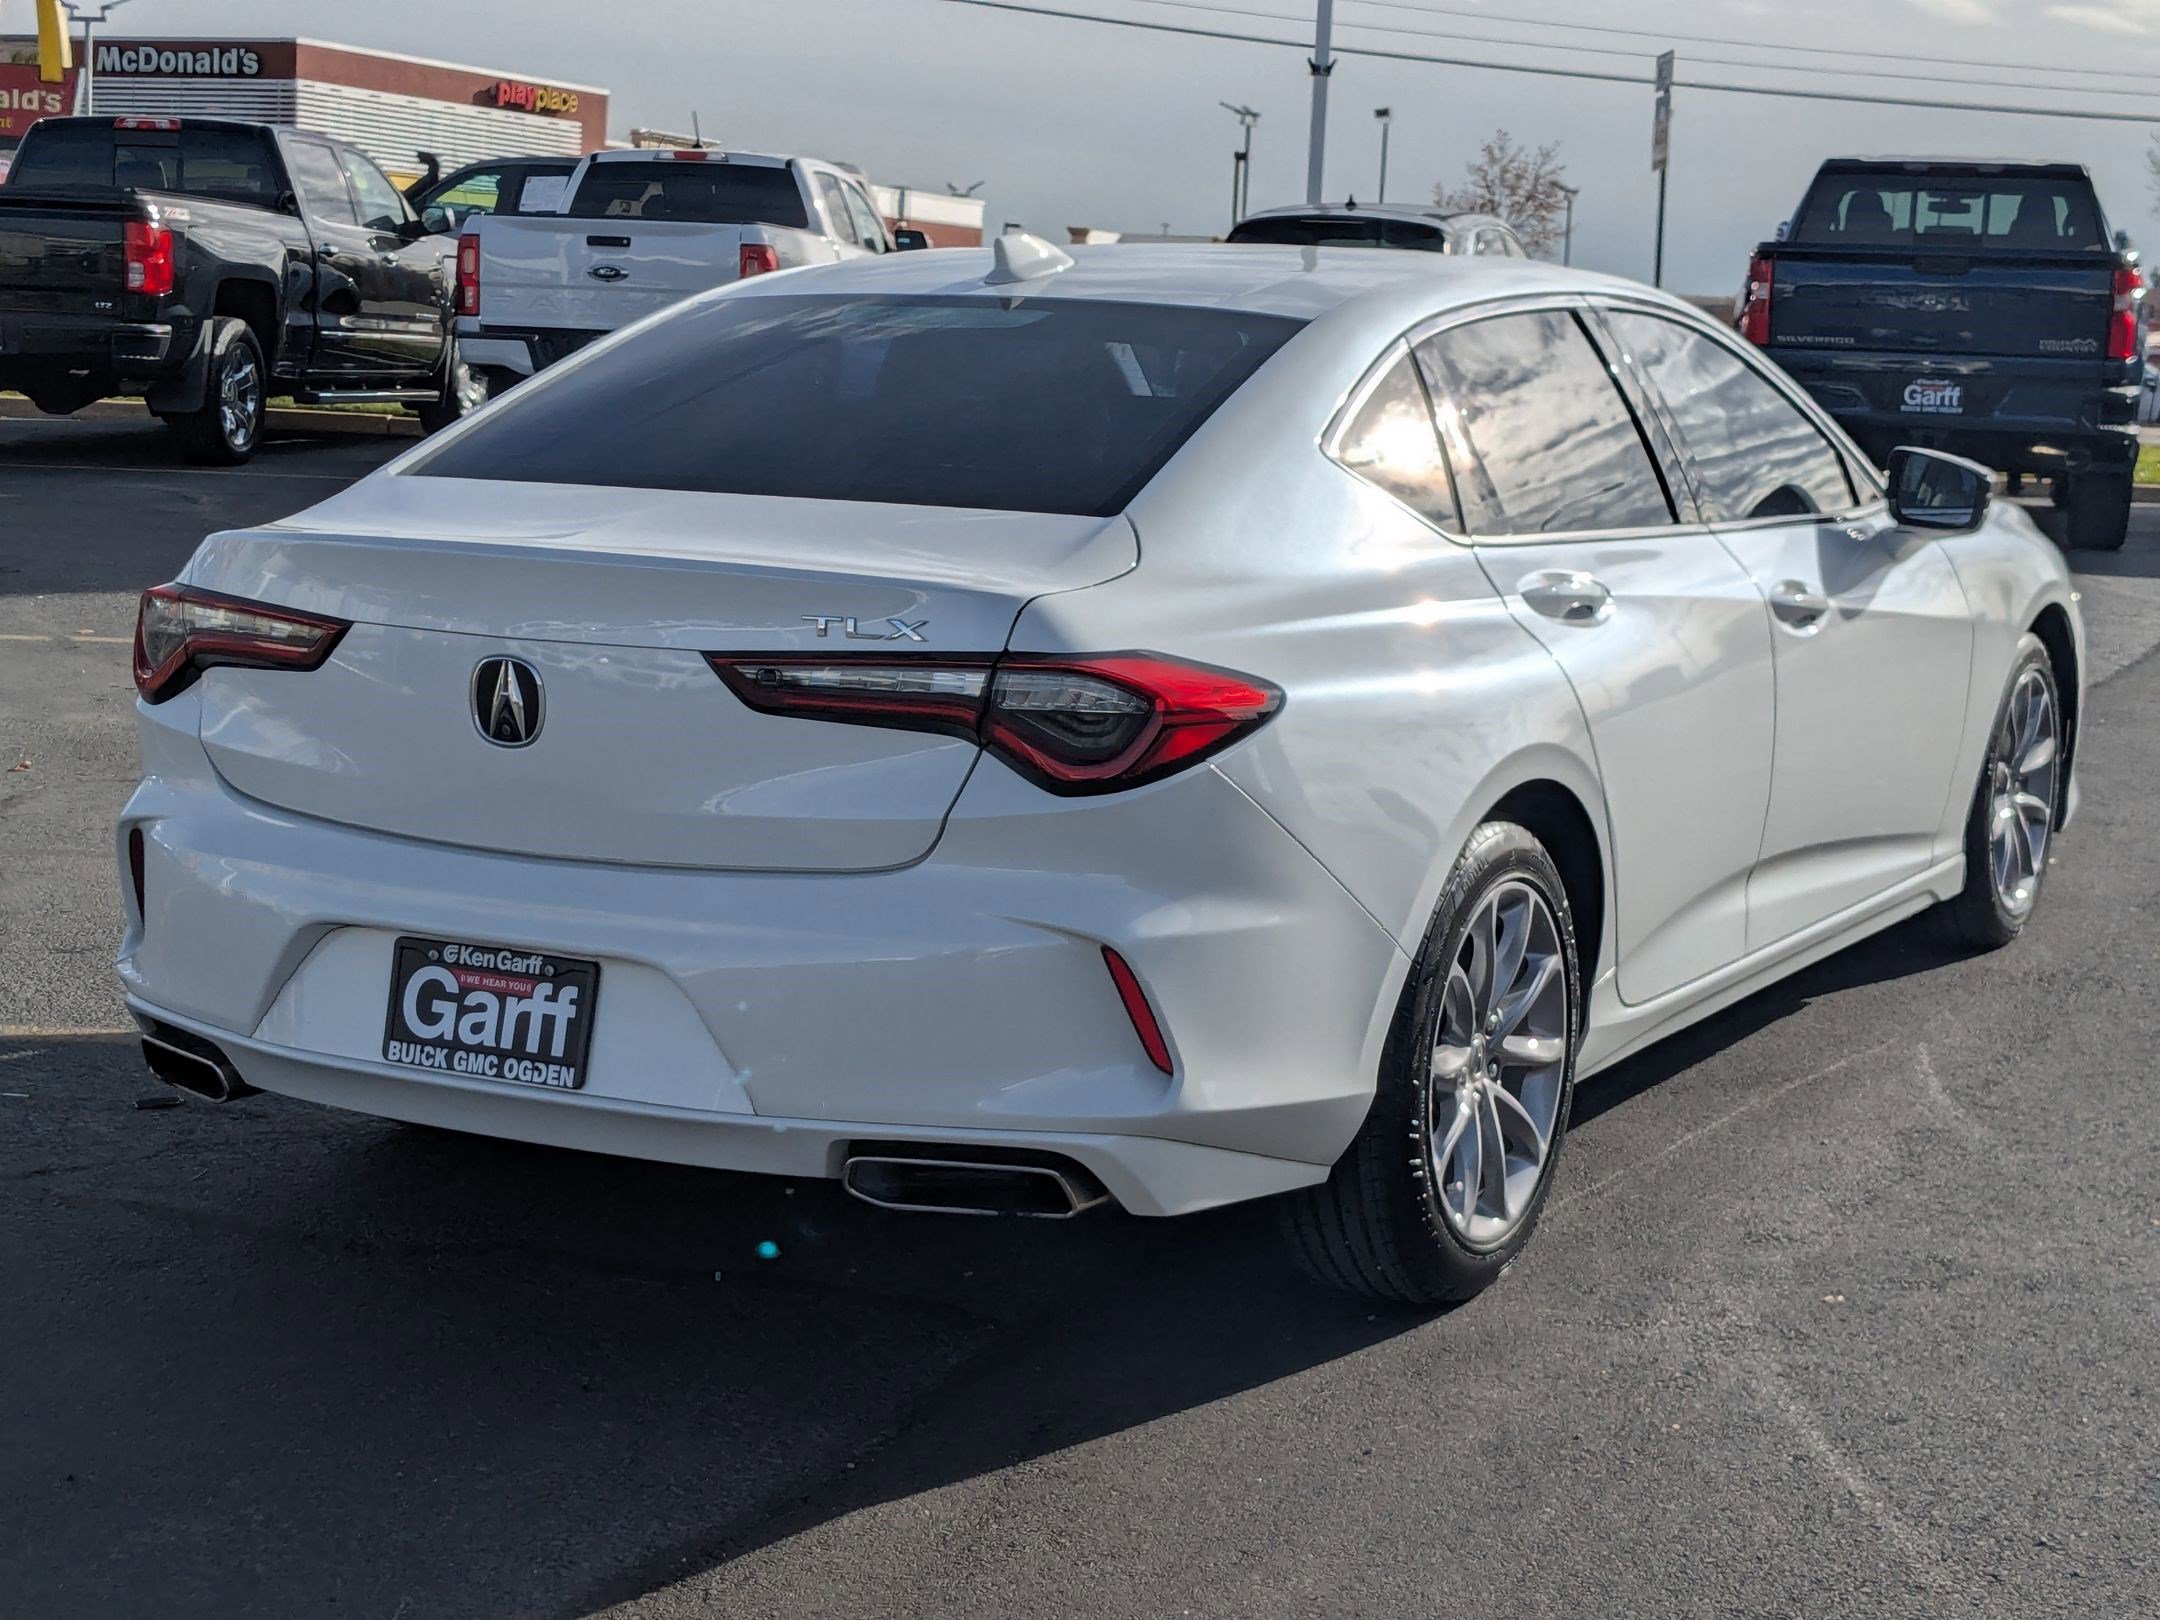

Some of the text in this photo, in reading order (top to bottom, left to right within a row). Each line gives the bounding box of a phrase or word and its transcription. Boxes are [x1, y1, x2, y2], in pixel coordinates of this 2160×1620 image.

[96, 45, 259, 75] McDonald's
[1903, 384, 1961, 407] Garff
[801, 614, 930, 642] TLX
[466, 975, 526, 991] WE HEAR YOU
[402, 965, 579, 1058] Garff
[388, 1040, 575, 1088] BUICK GMC OGDEN
